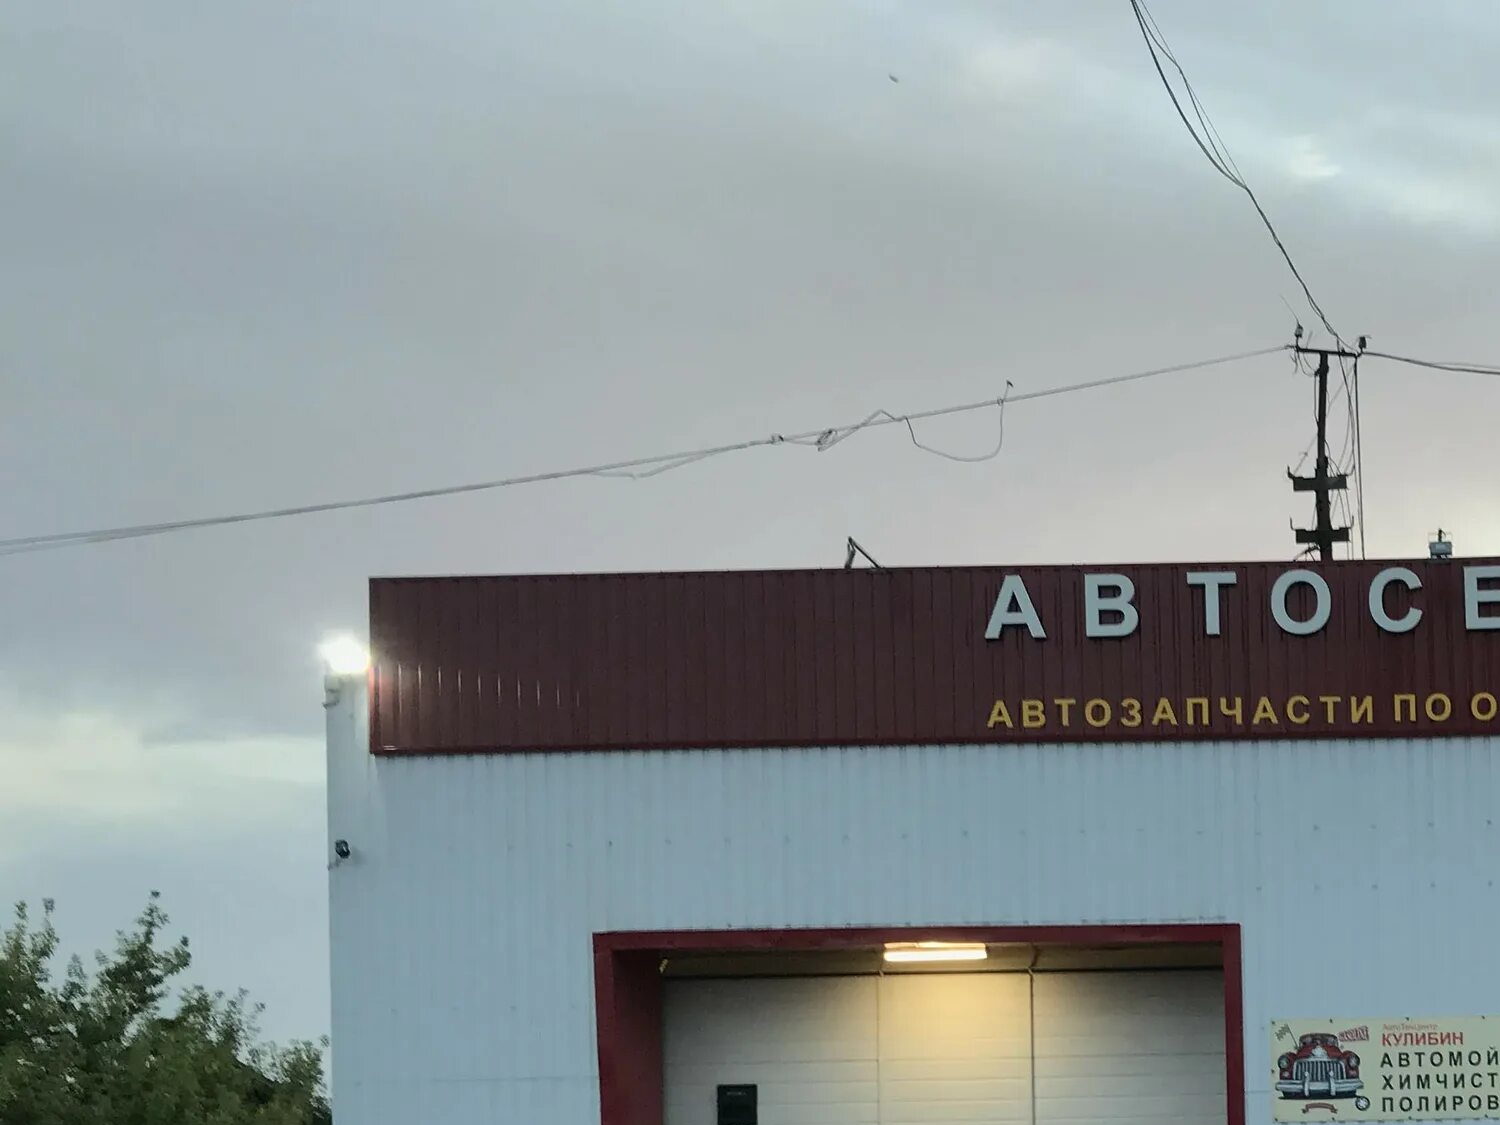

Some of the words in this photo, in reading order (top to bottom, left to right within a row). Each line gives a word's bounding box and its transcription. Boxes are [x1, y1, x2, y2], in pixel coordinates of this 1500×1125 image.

[986, 696, 1375, 729] АВТОЗАПЧАСТИ
[1393, 692, 1452, 723] ПО
[1381, 1031, 1464, 1047] КУЛИБИН
